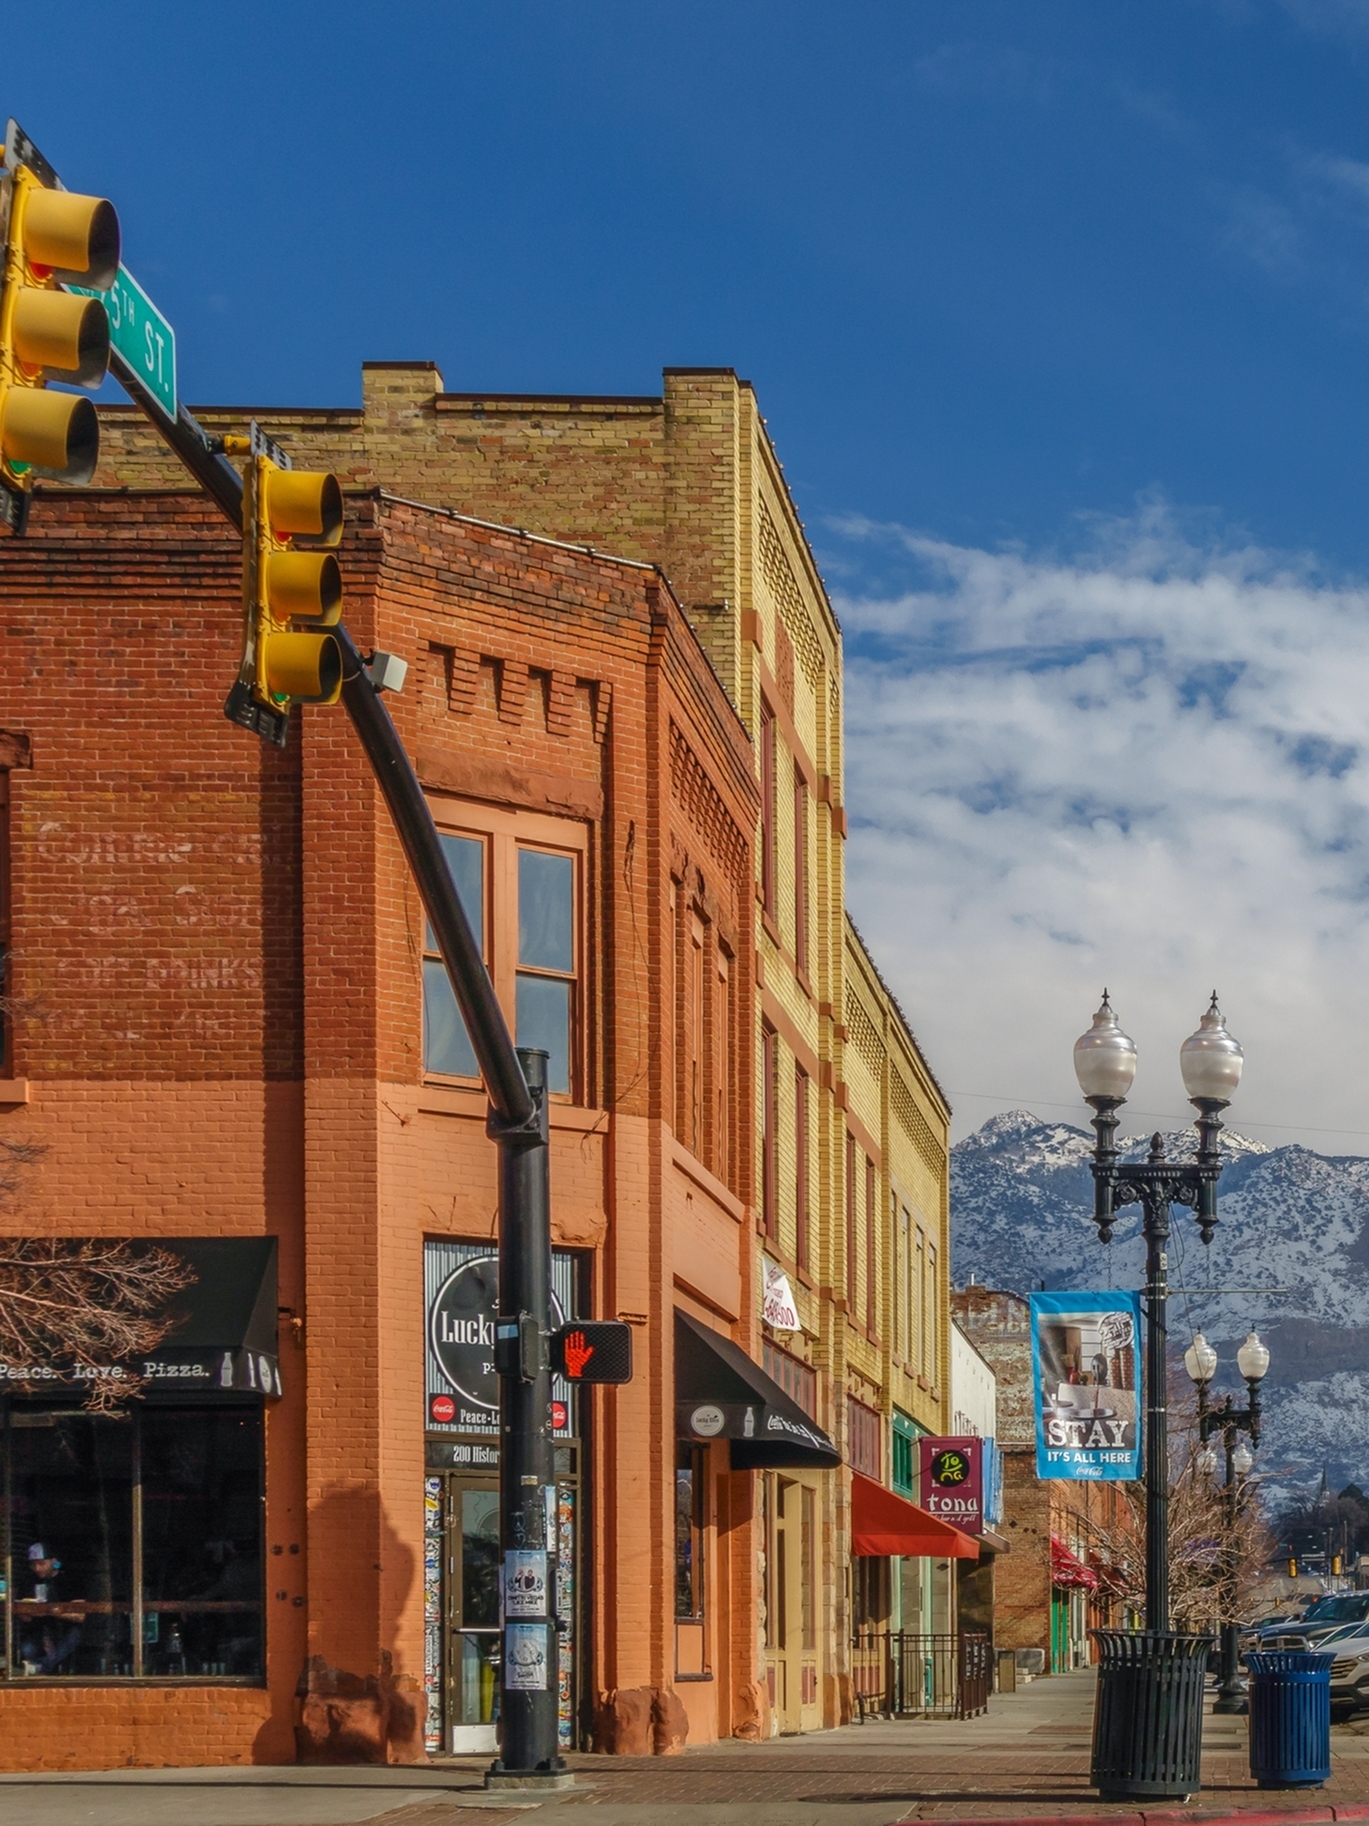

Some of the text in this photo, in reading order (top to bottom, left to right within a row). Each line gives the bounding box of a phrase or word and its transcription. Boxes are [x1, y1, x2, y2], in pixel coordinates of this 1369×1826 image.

[144, 320, 169, 393] ST.
[0, 1362, 210, 1379] Peace. Love. Pizza.
[1048, 1419, 1129, 1448] STAY
[453, 1445, 471, 1462] 200
[1047, 1451, 1131, 1463] IT'S ALL HERE
[926, 1493, 978, 1511] tona
